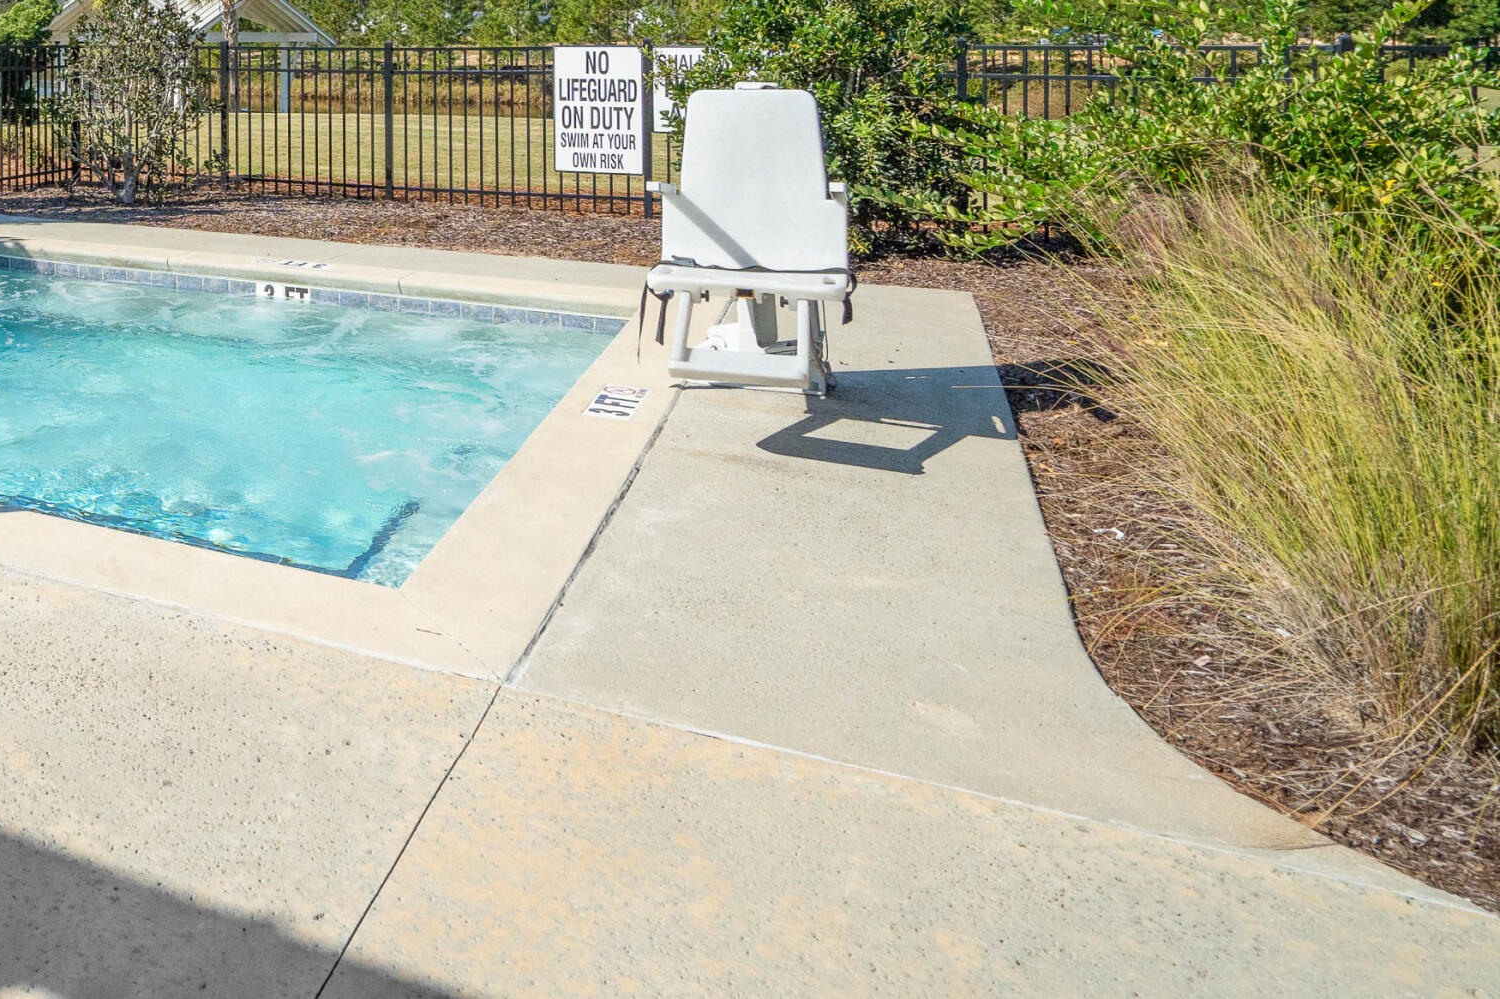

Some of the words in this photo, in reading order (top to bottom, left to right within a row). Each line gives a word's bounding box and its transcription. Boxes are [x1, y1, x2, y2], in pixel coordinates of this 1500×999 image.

[586, 51, 609, 74] NO
[559, 78, 637, 102] LIFEGUARD
[562, 106, 584, 129] ON
[591, 107, 634, 130] DUTY
[560, 133, 589, 148] SWIM
[592, 134, 603, 148] AT
[608, 134, 636, 150] YOUR
[572, 152, 596, 168] OWN
[600, 154, 624, 169] RISK
